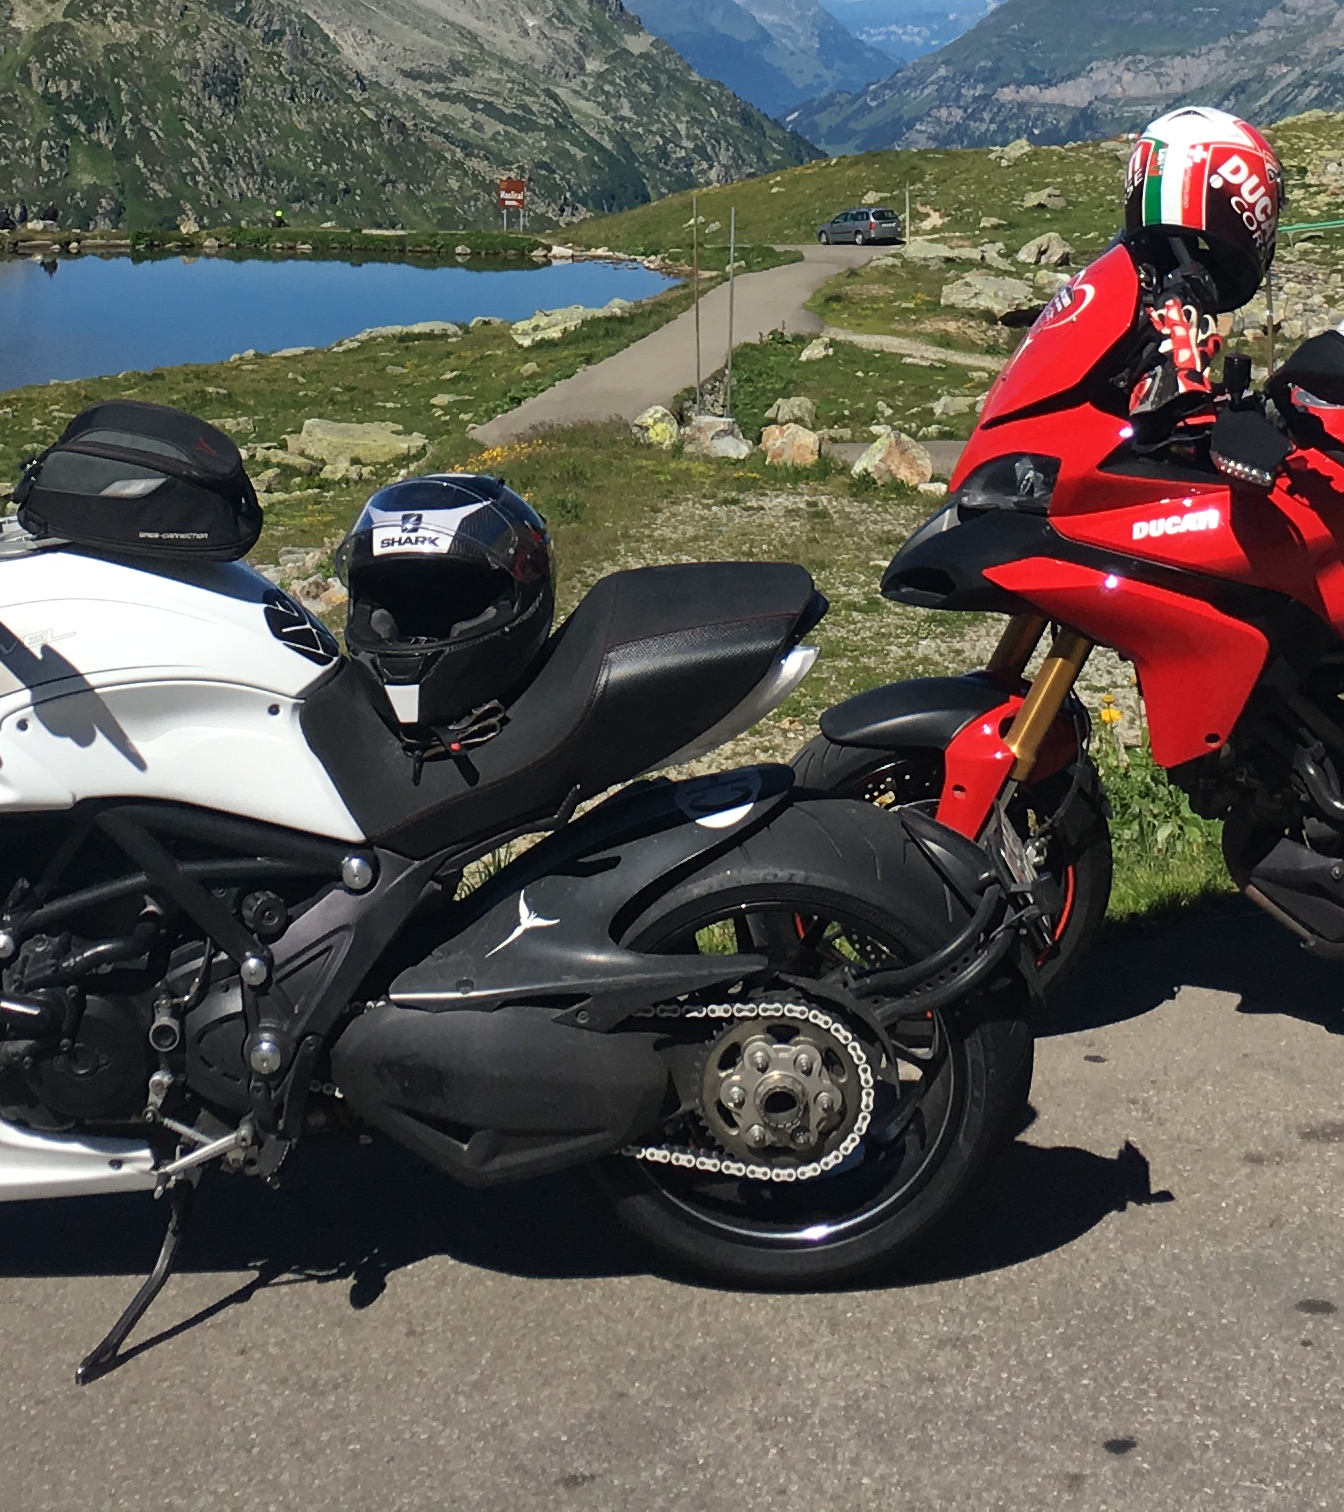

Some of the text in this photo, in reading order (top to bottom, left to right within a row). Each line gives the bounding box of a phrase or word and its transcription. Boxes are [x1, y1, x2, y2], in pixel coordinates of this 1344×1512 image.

[1217, 154, 1276, 250] DUCAT
[1132, 508, 1220, 540] DUCATI
[380, 535, 440, 549] SHARK
